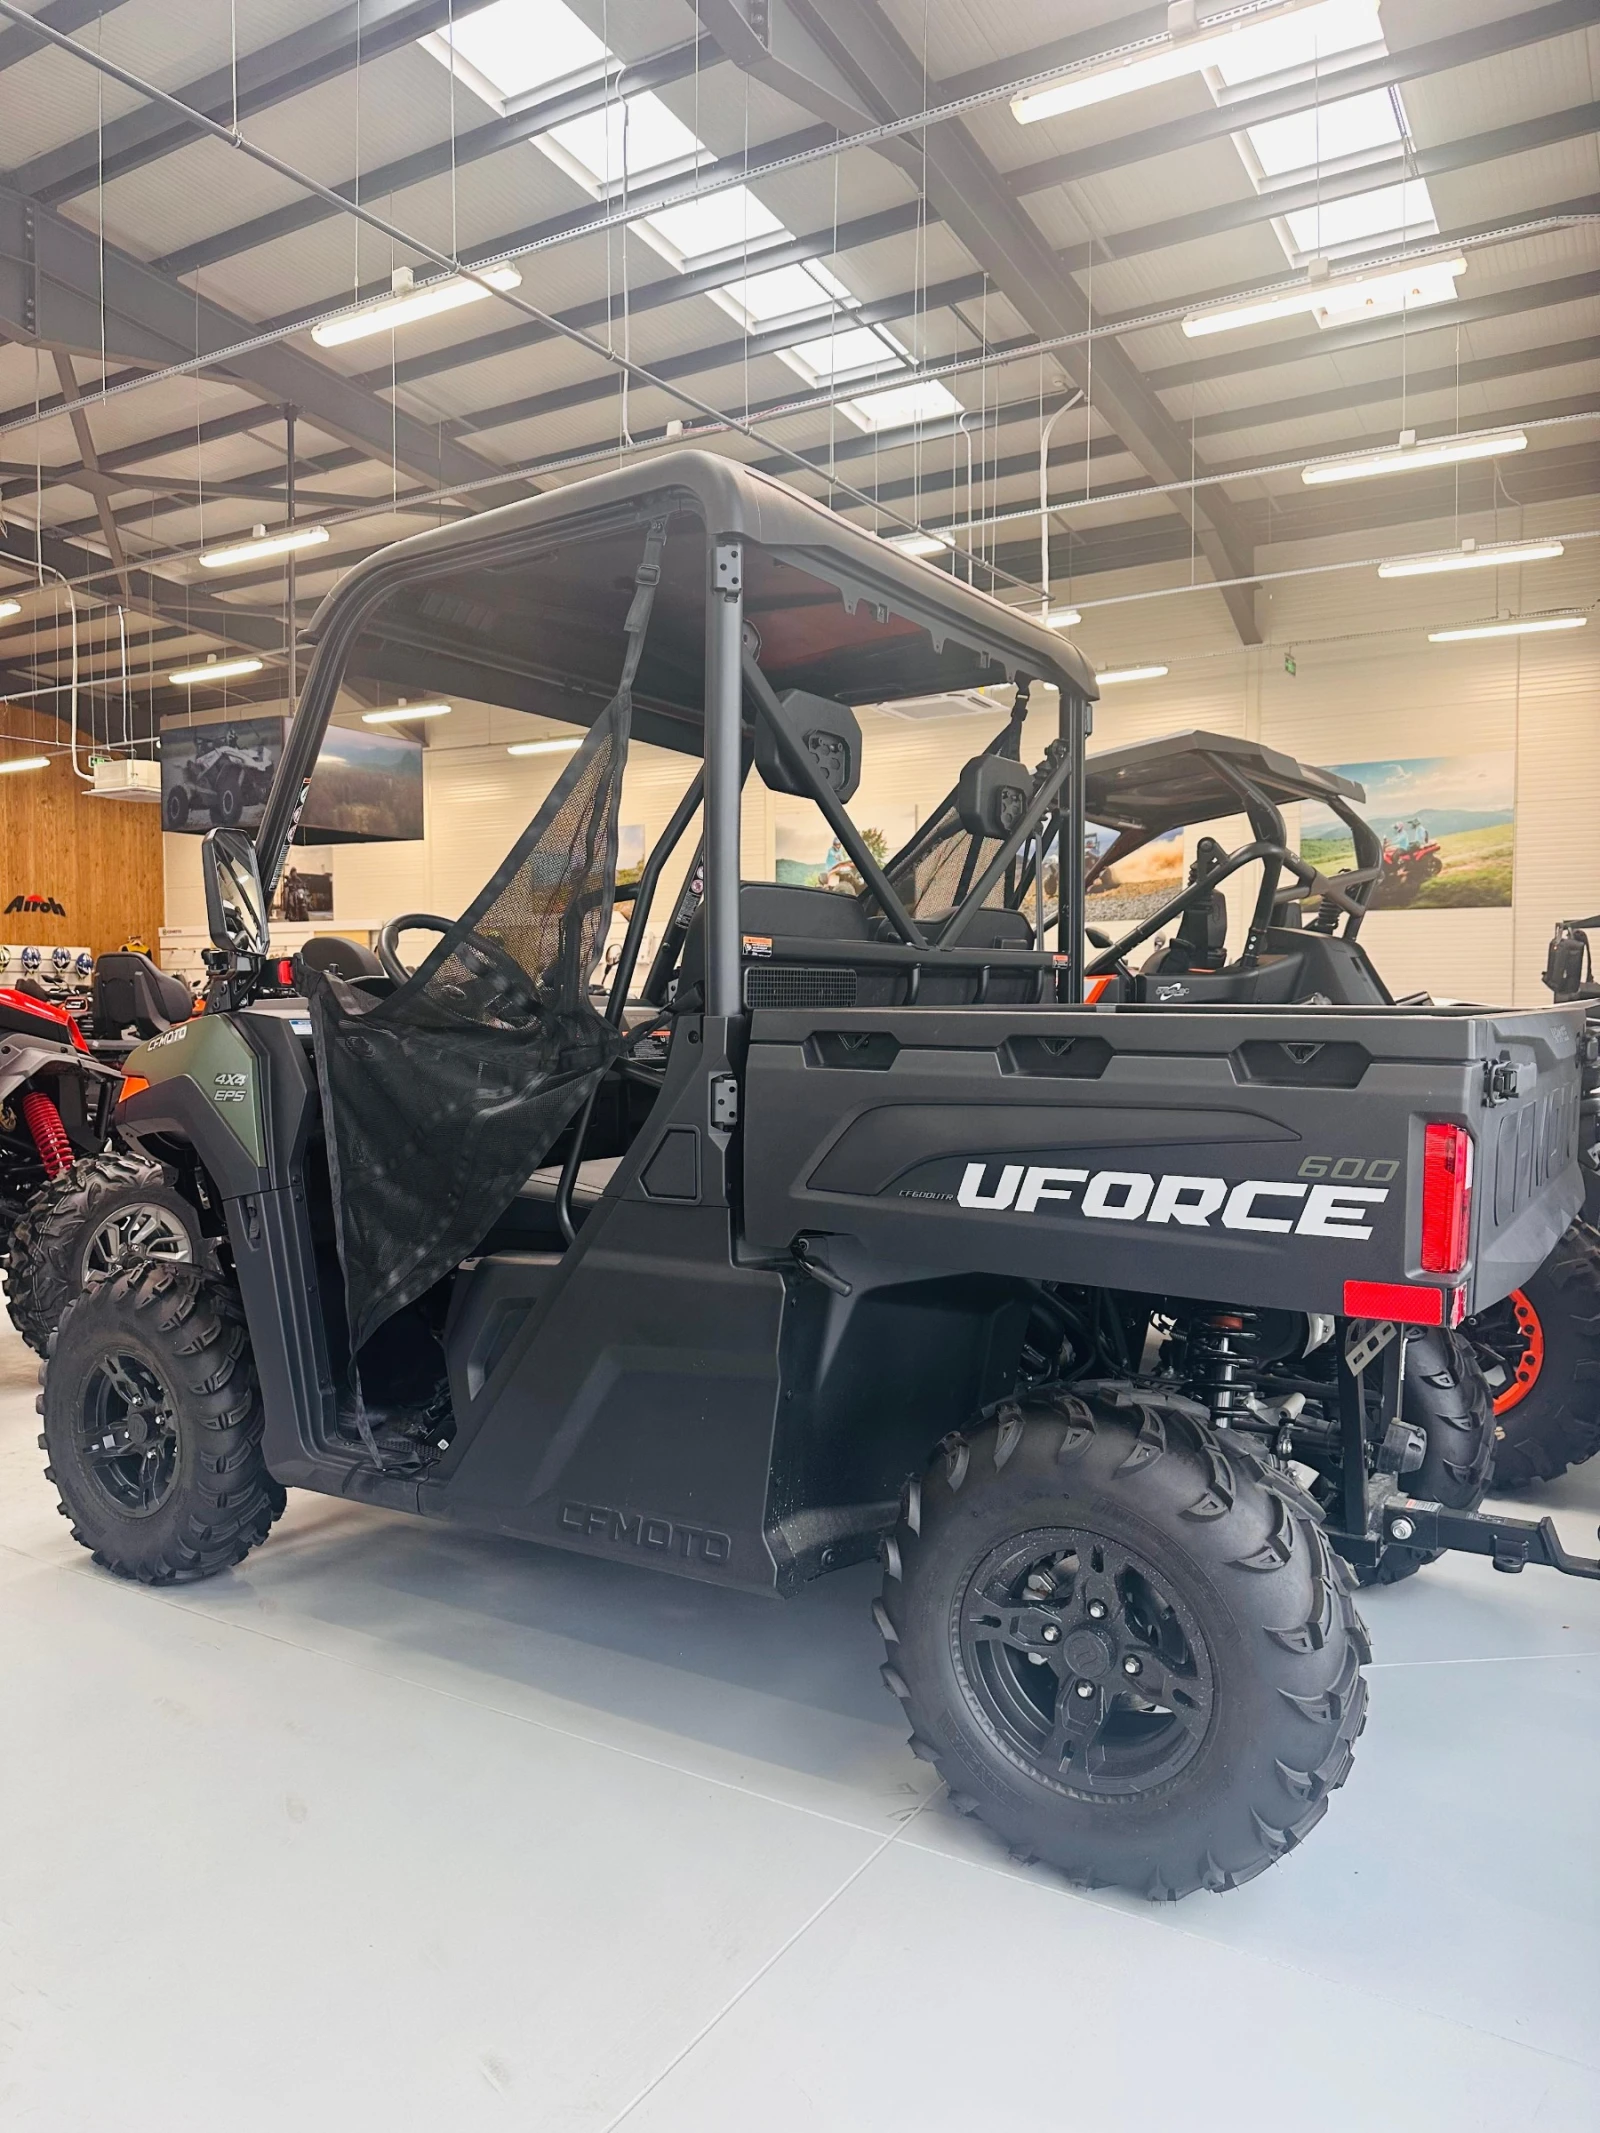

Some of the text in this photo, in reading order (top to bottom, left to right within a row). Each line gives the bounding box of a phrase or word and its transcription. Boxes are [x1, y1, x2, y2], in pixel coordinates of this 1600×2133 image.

[4, 895, 66, 917] Airoh
[147, 1025, 188, 1051] CFMOTO
[215, 1074, 247, 1086] 4X4
[214, 1090, 246, 1102] EPS
[1297, 1156, 1401, 1182] 600
[898, 1190, 954, 1201] CF600UTR
[957, 1162, 1389, 1241] UFORCE
[559, 1500, 731, 1563] CFMOTO
